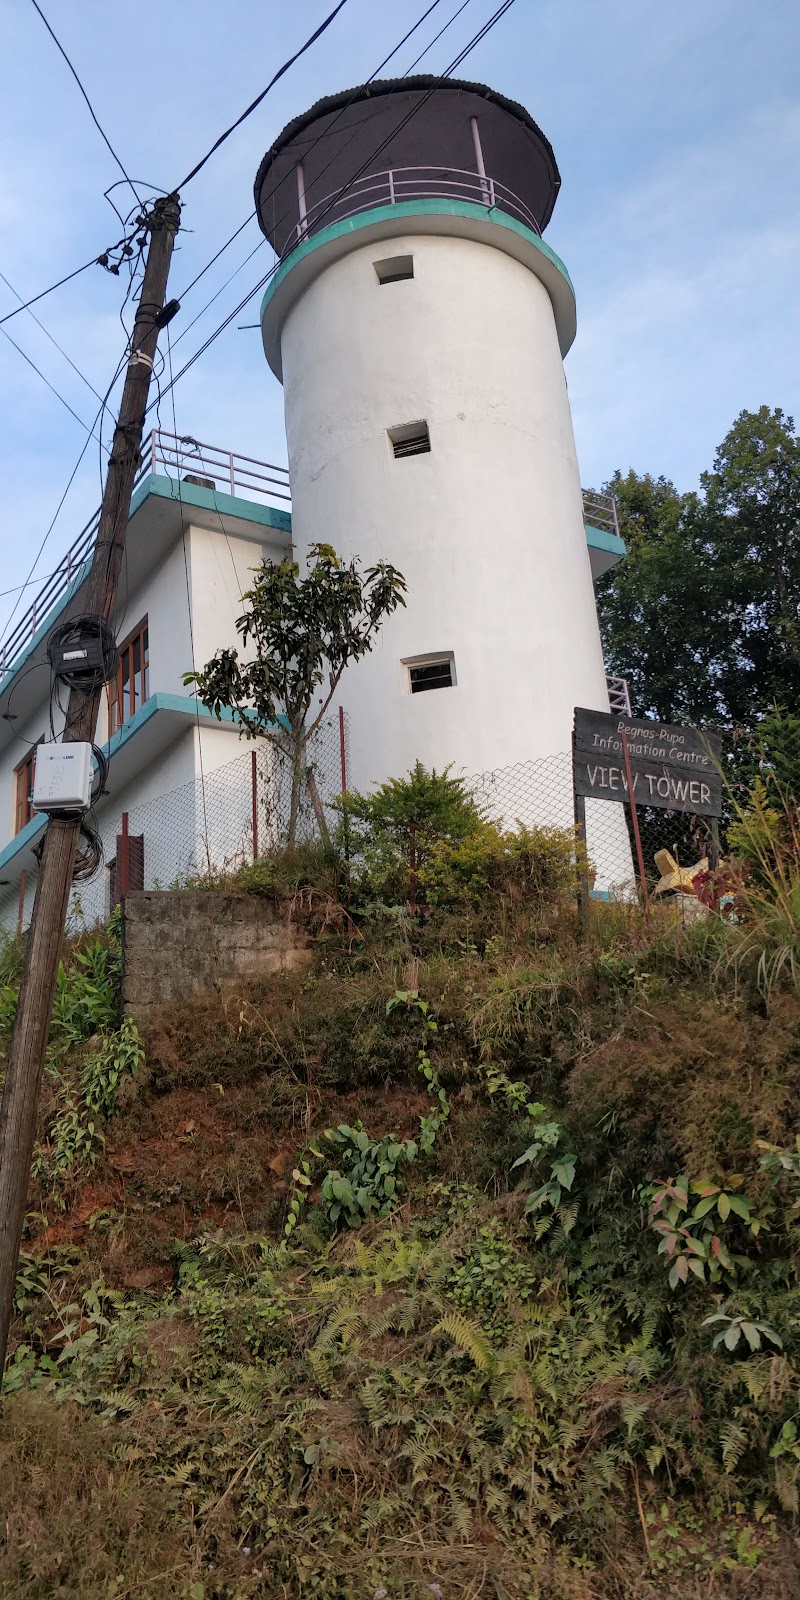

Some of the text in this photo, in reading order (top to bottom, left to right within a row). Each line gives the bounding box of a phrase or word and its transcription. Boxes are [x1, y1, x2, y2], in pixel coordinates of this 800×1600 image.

[617, 721, 685, 744] Begnas-Rupa
[669, 748, 709, 765] Centre
[586, 764, 711, 804] VIEW TOWER
